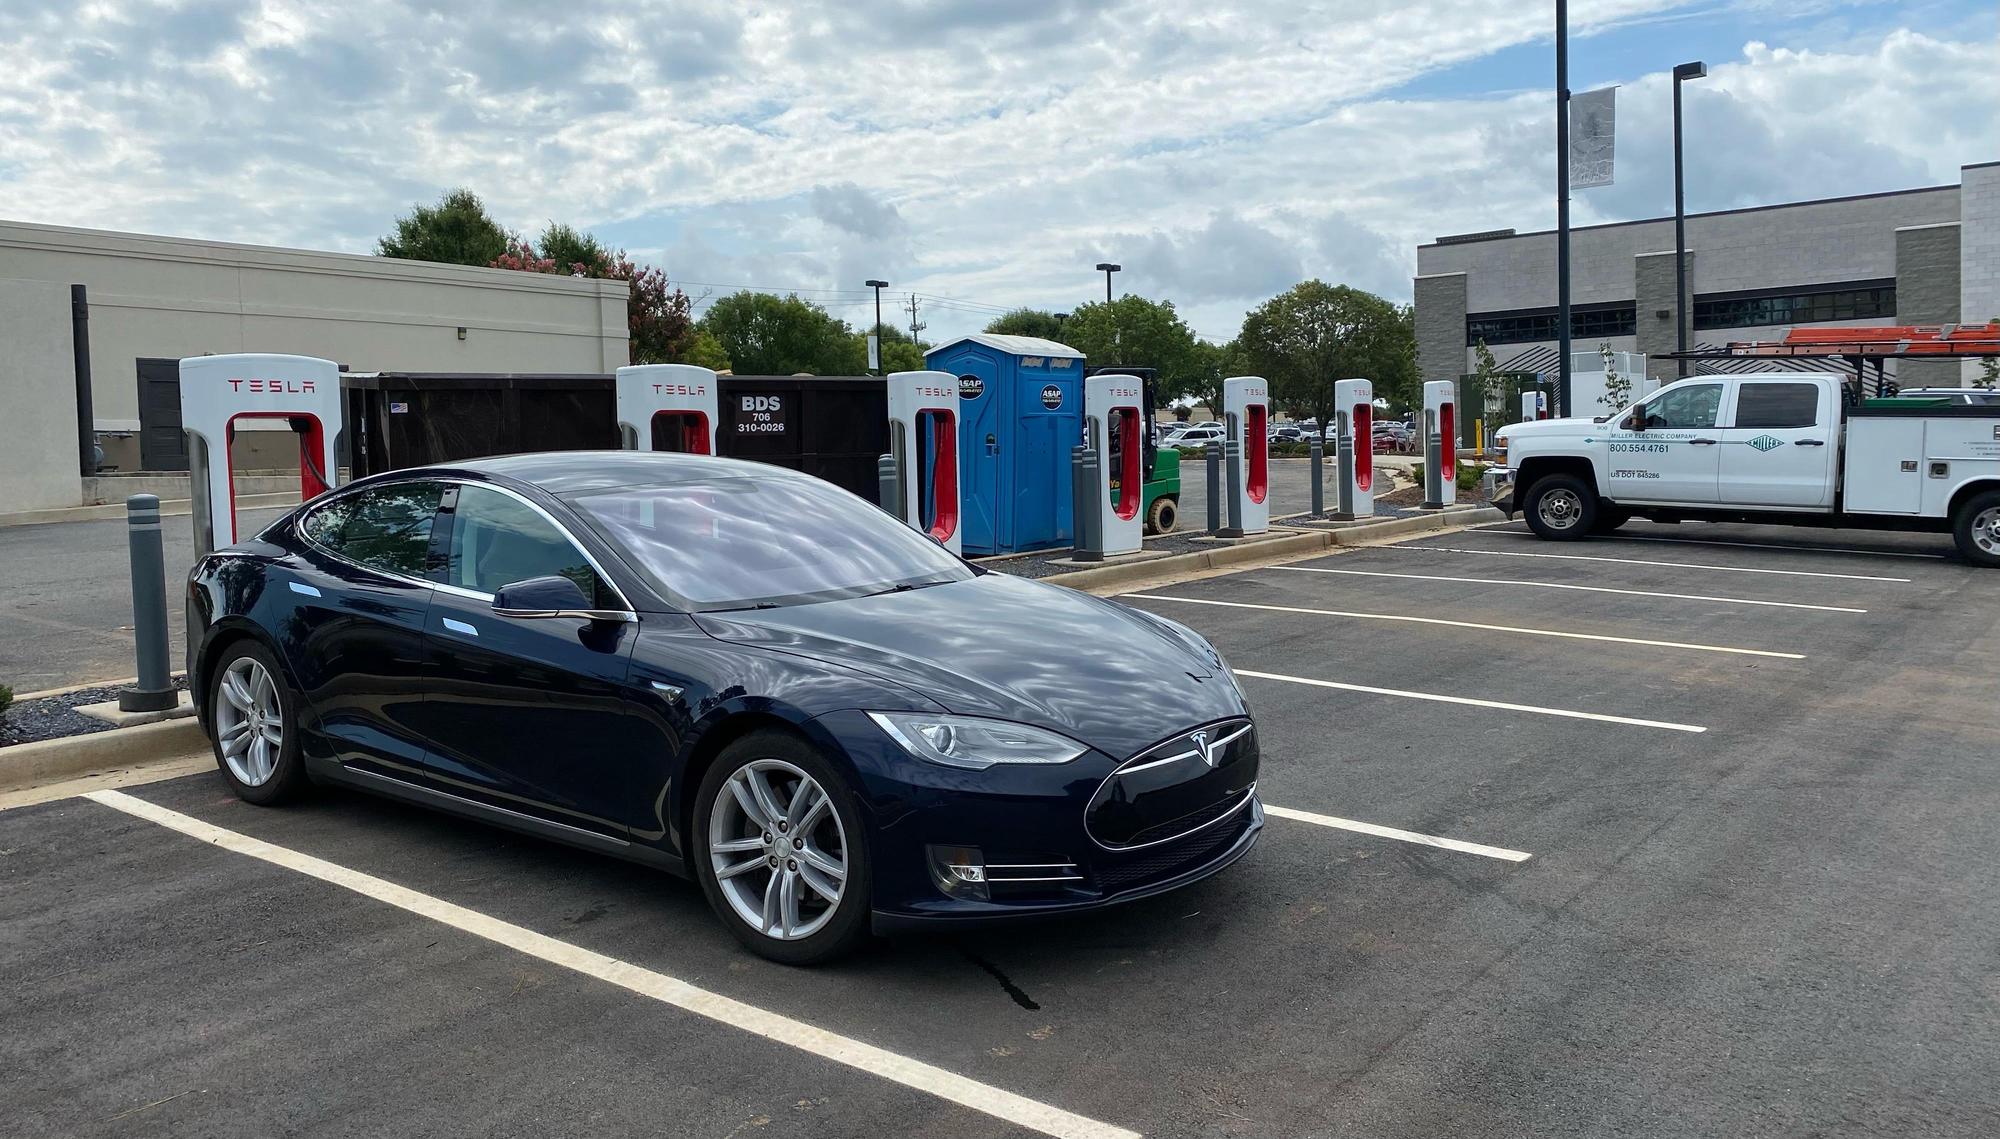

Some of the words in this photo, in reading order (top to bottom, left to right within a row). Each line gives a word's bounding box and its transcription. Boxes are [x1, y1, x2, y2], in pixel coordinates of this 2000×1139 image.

[227, 379, 315, 393] TESLA
[652, 384, 705, 396] TESLA
[915, 387, 952, 397] TESLA
[1109, 388, 1137, 397] TESLA
[742, 395, 780, 411] BDS
[753, 413, 770, 421] 706
[738, 423, 784, 432] 310-0026
[1752, 435, 1777, 450] MILLER
[1609, 444, 1669, 452] 800.554.4761
[1110, 480, 1120, 488] Ya
